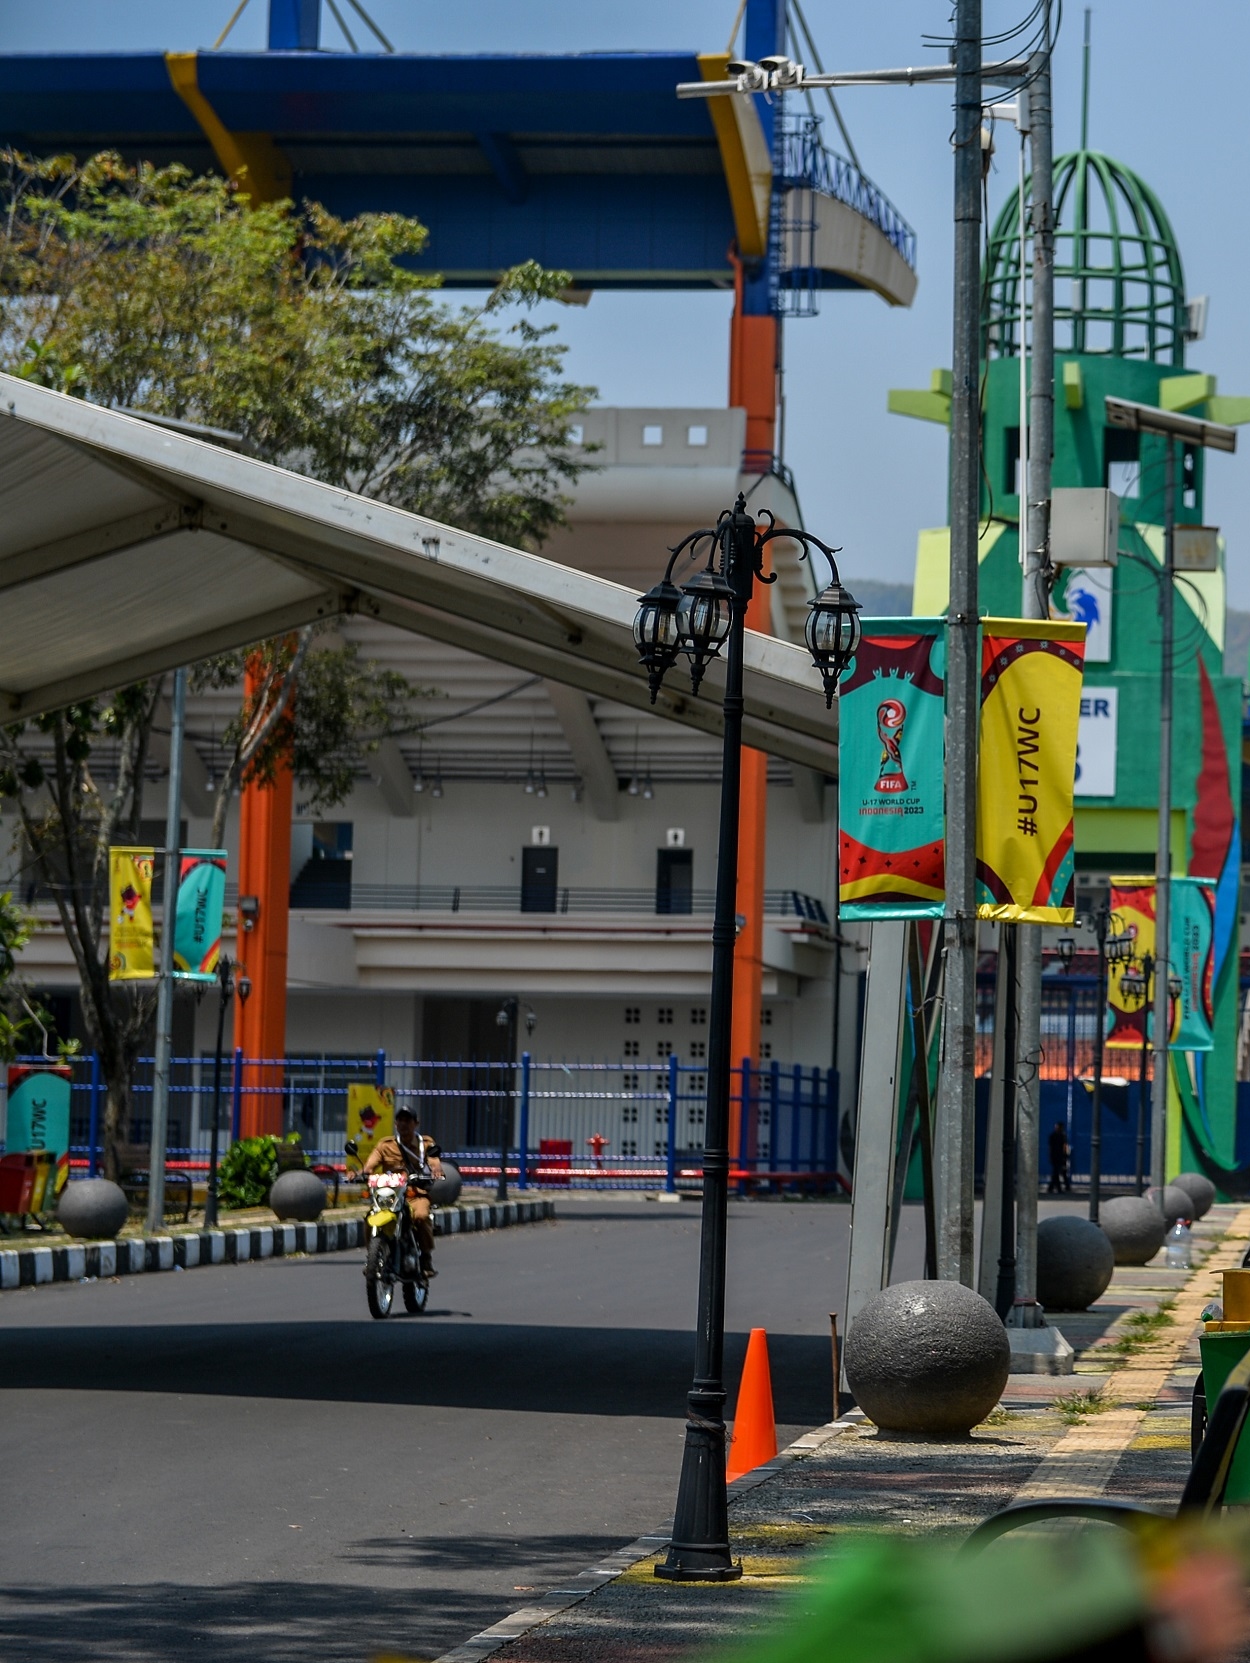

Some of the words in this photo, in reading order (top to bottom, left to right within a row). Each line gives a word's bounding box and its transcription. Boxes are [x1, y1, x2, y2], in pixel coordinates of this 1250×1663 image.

[1080, 698, 1111, 718] ER
[1017, 706, 1041, 837] #U17WC
[880, 780, 902, 789] FIFA
[862, 798, 877, 806] U-17
[879, 798, 904, 806] WORLD
[906, 797, 921, 805] CUP
[859, 807, 903, 817] INDONESIA
[903, 806, 924, 815] 2023
[31, 1098, 47, 1150] U17WC
